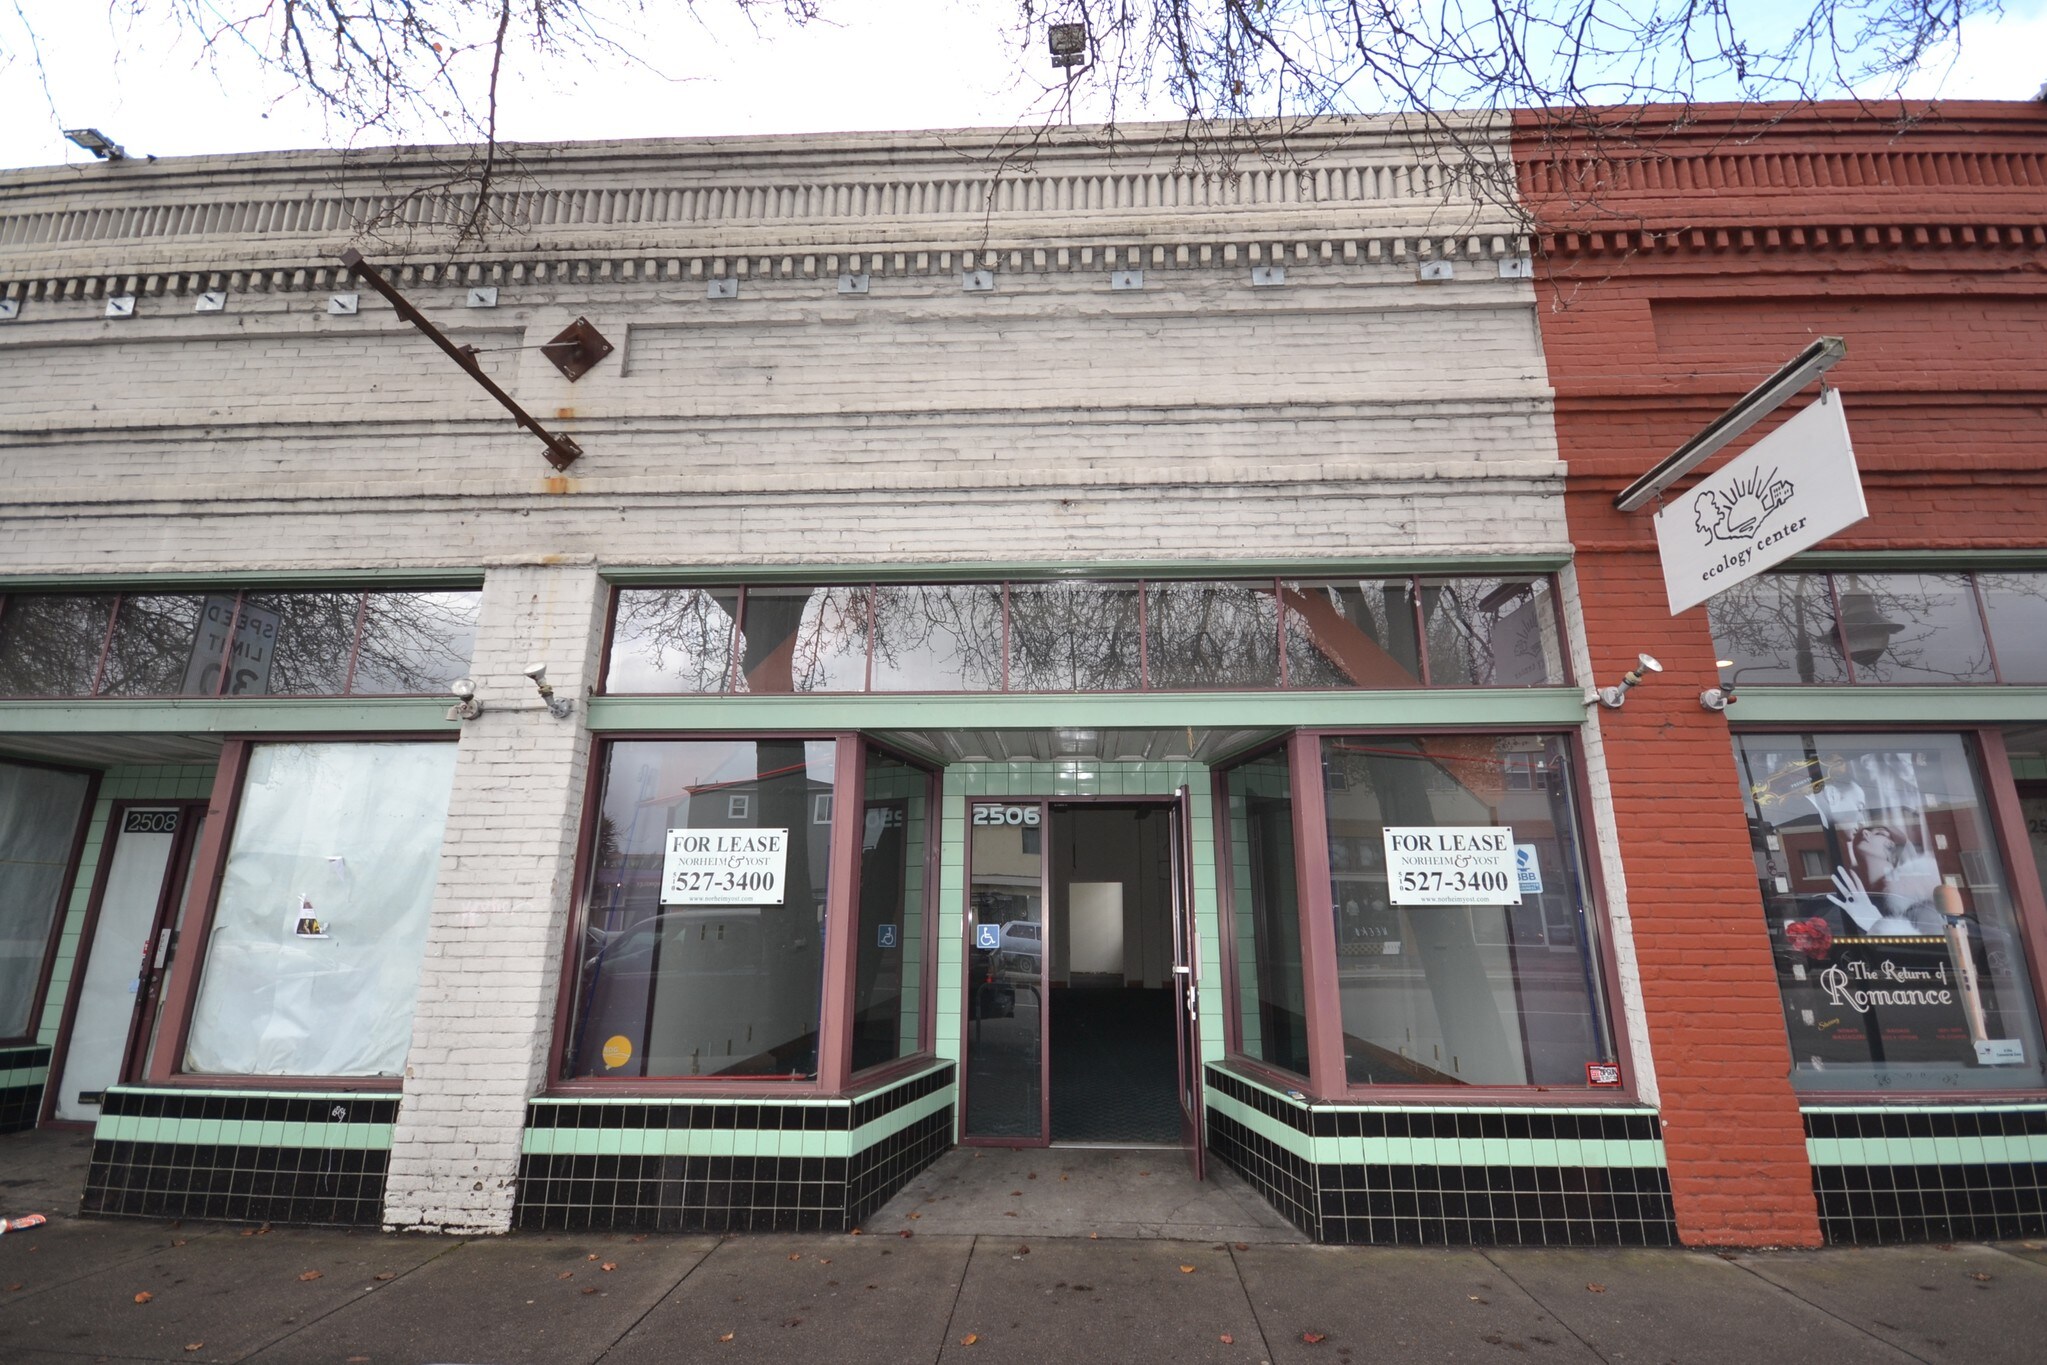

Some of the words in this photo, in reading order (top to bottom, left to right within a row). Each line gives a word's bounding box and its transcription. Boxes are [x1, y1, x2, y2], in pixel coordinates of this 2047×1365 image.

[1702, 546, 1752, 581] ecology
[1757, 517, 1807, 551] center
[127, 813, 178, 831] 2508
[973, 806, 1040, 825] 2506
[672, 836, 710, 852] FOR
[717, 836, 780, 852] LEASE
[1391, 834, 1434, 851] FOR
[1439, 834, 1507, 851] LEASE
[678, 857, 727, 866] NORHEIM
[745, 857, 771, 866] YOST
[1401, 856, 1454, 866] NORHEIM
[1472, 856, 1500, 866] YOST
[676, 871, 775, 891] 527-3400
[1403, 871, 1508, 892] 527-3400
[689, 895, 754, 903] www.norheimyost.com
[1420, 895, 1490, 904] www.norheimyost.com
[1847, 960, 1879, 980] The
[1881, 959, 1932, 983] Return
[1935, 961, 1947, 985] of
[1820, 964, 1952, 1013] Romance
